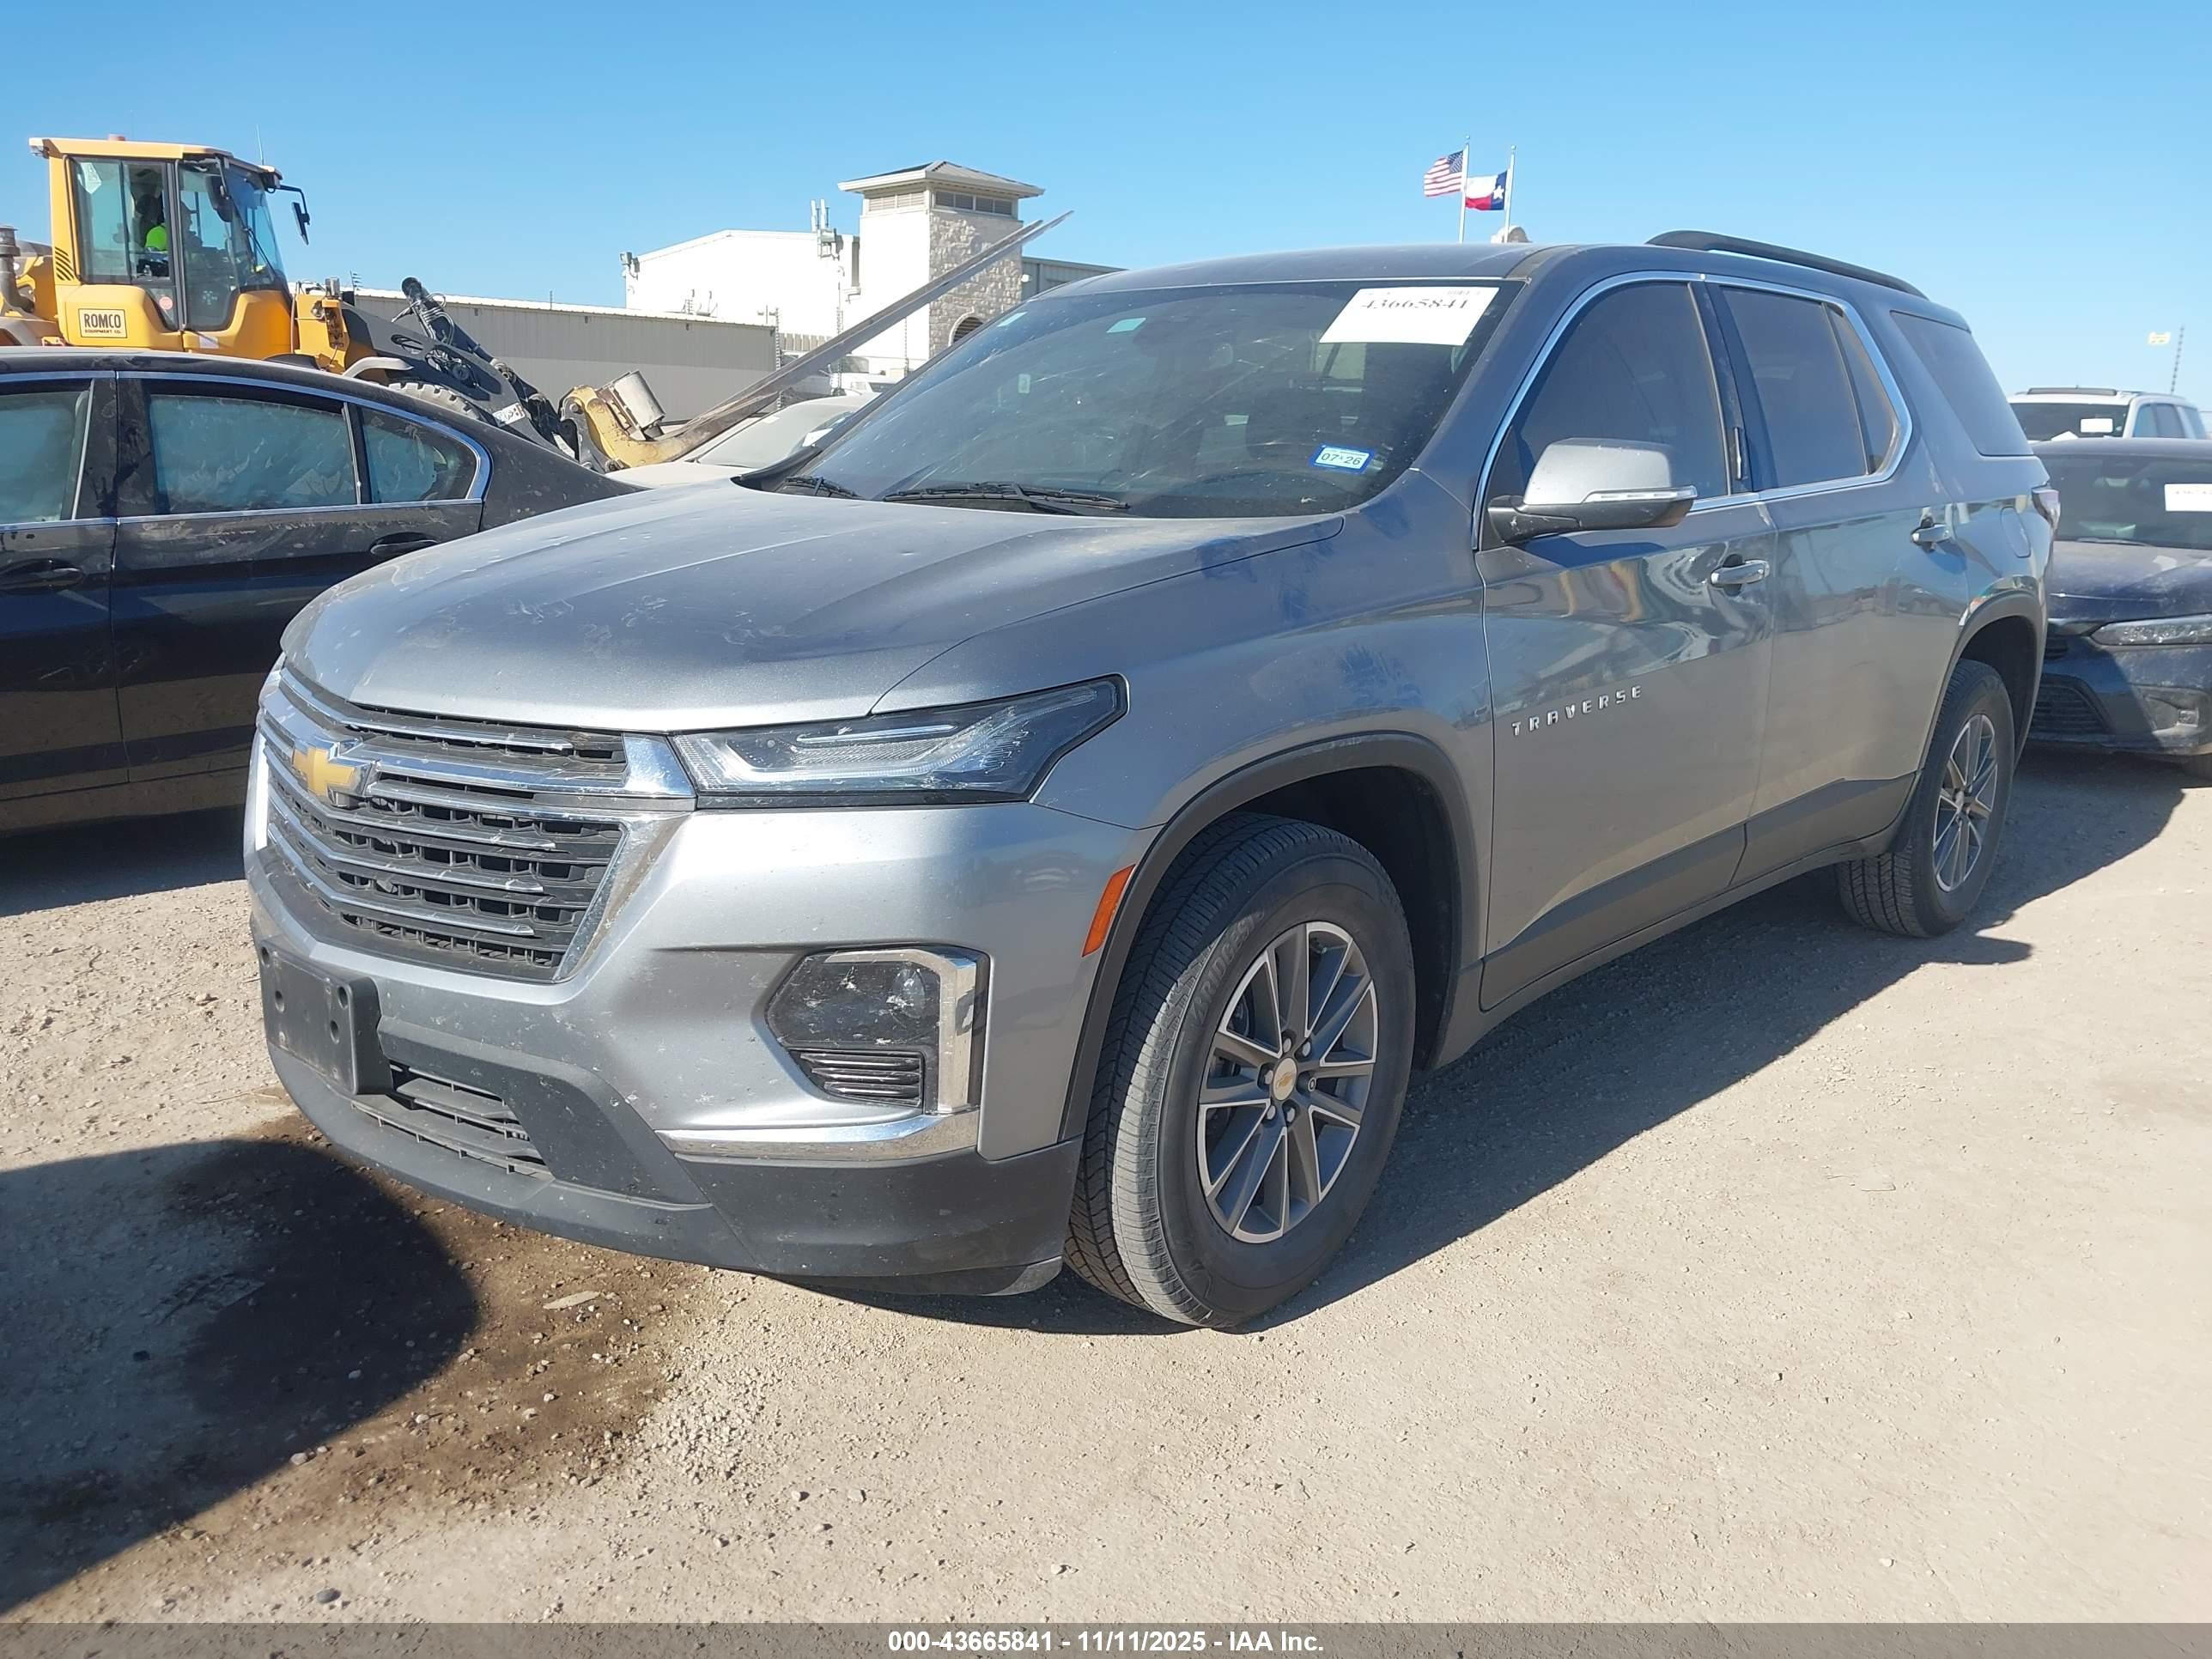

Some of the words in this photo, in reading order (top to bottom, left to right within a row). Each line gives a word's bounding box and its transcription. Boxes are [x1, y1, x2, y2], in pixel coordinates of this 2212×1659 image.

[1361, 299, 1468, 309] 43665841
[84, 313, 121, 328] ROMCO
[1321, 453, 1340, 461] 07
[1343, 456, 1362, 465] 26
[1511, 685, 1641, 736] TRAVERSE
